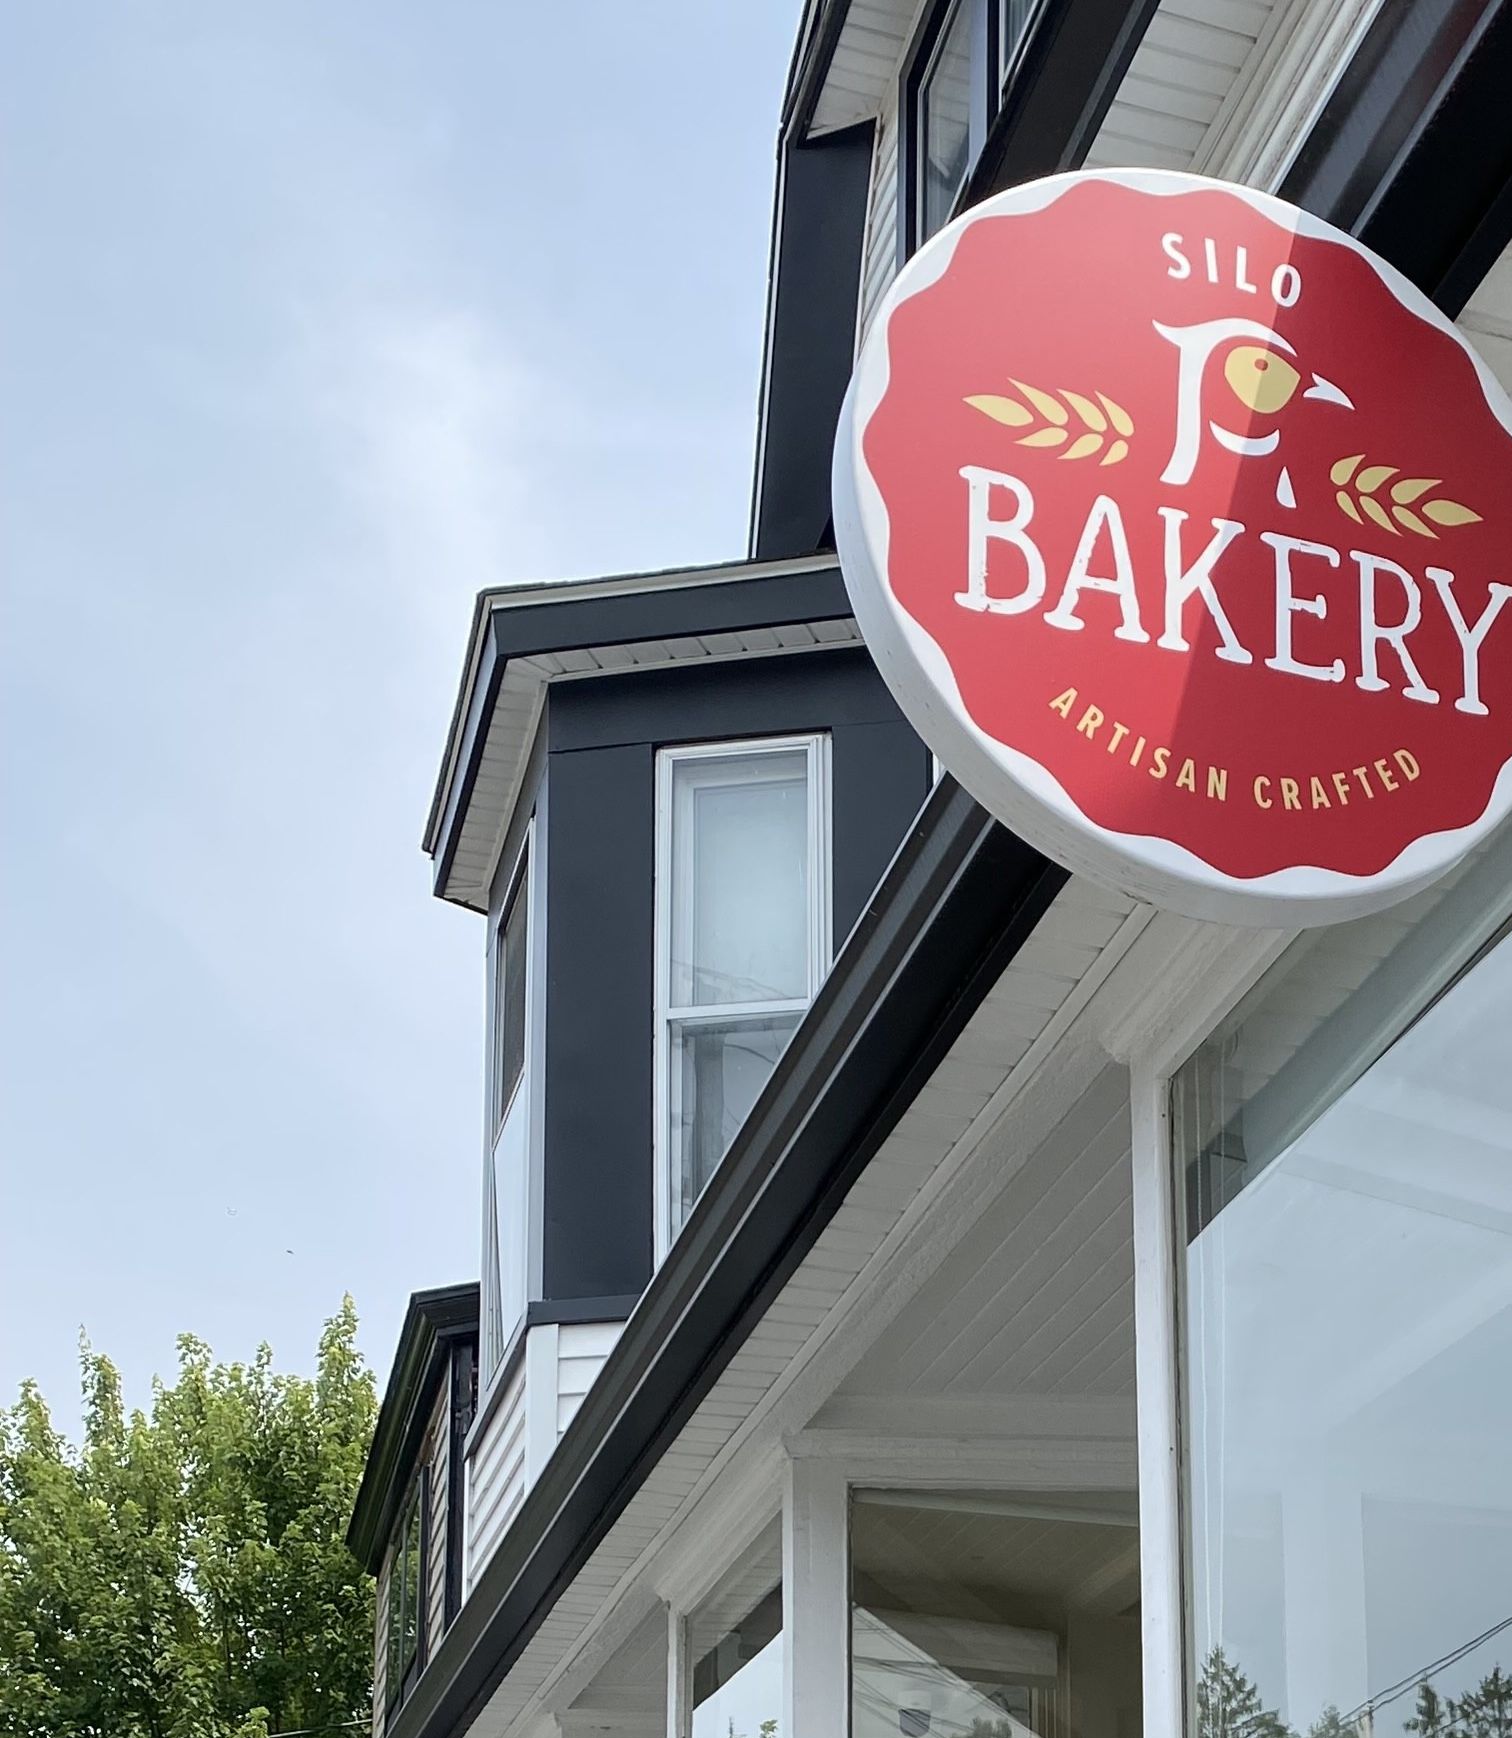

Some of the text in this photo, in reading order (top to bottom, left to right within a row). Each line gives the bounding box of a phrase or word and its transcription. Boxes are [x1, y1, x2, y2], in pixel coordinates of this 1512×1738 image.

[1161, 232, 1302, 308] SILO
[1048, 687, 1422, 811] ARTISAN CRAFTED
